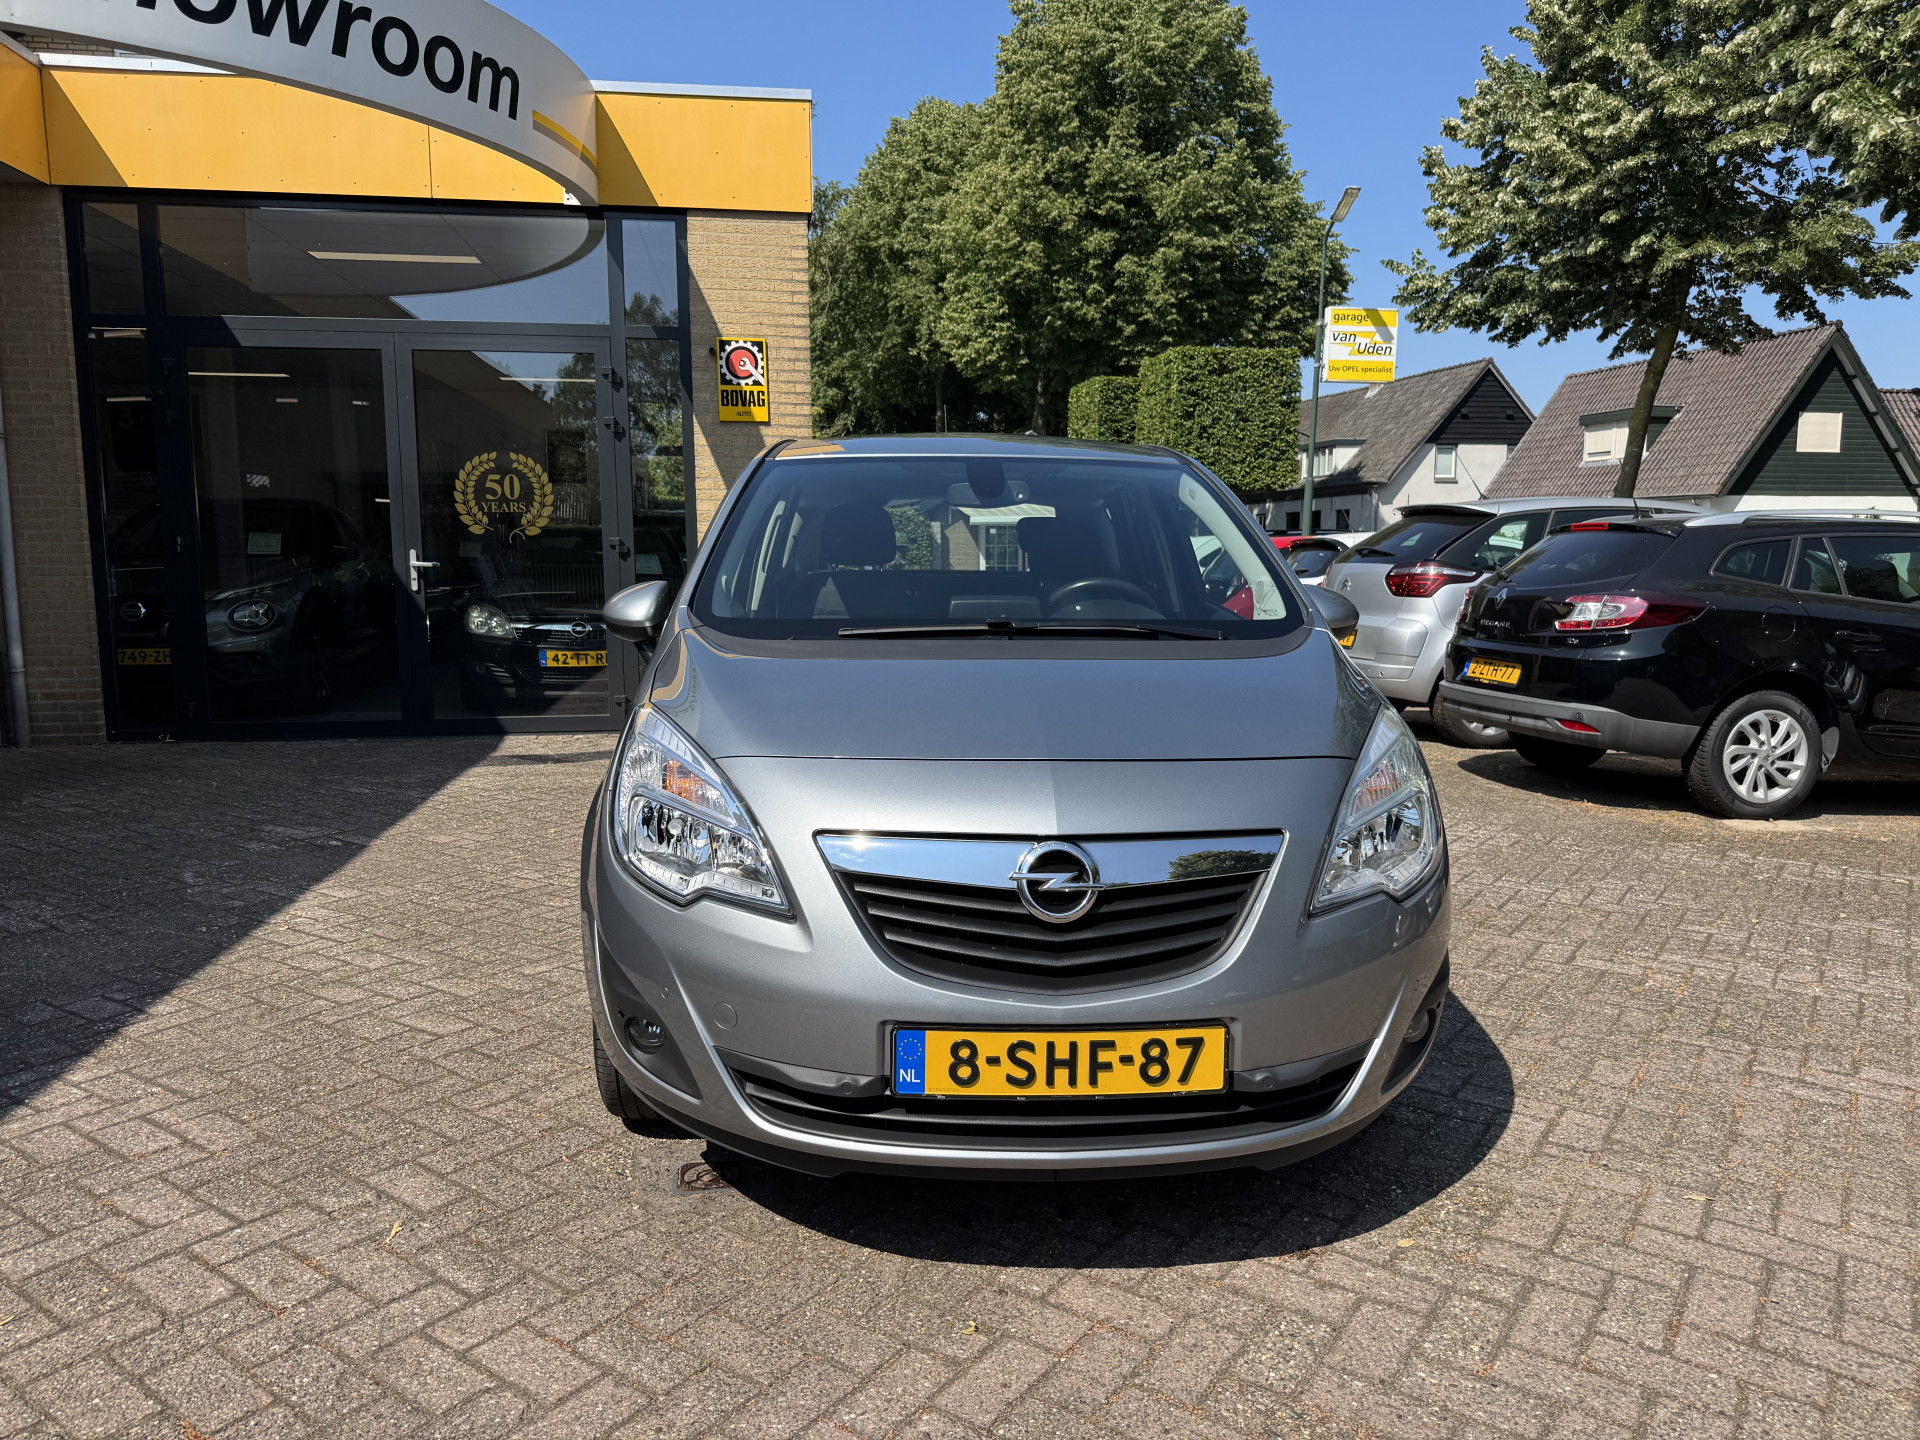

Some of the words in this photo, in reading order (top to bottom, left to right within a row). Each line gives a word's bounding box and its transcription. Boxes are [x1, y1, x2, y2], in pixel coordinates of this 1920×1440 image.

[136, 0, 520, 121] wroom
[1333, 313, 1370, 324] garage
[1332, 332, 1357, 343] van
[1357, 342, 1393, 356] Uden
[1342, 365, 1360, 373] OPEL
[1361, 366, 1393, 374] specialist
[721, 389, 766, 407] BOVAG
[484, 473, 521, 500] 50
[481, 501, 527, 513] YEARS
[552, 652, 608, 665] 42-TT-R
[1471, 660, 1516, 680] 2-ZTH-77
[948, 1036, 1205, 1088] 8-SHF-87
[899, 1069, 921, 1083] NL
